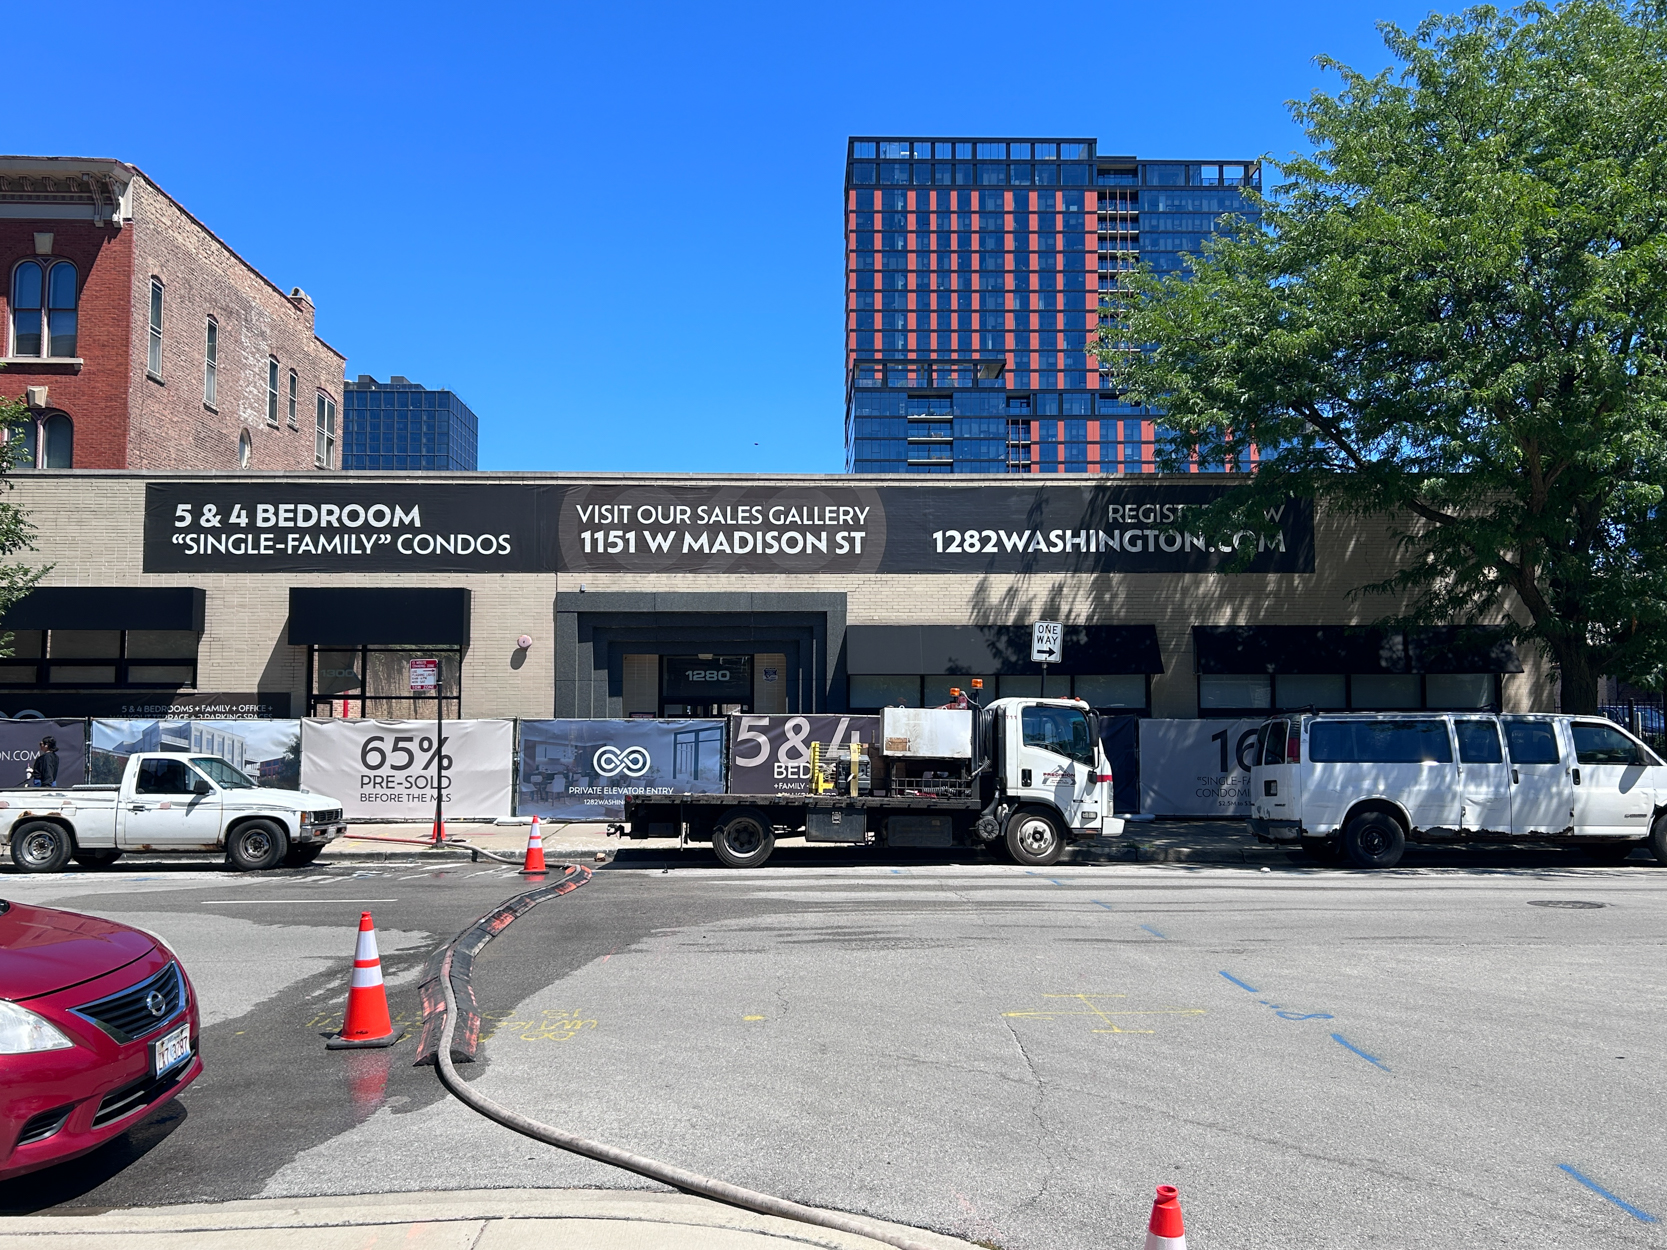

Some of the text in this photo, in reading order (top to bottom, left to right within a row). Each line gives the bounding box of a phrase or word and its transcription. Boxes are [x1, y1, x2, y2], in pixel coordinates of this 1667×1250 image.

[174, 503, 421, 528] 5 & 4 BEDROOM
[576, 505, 871, 525] VISIT OUR SALES GALLERY
[397, 533, 512, 555] CONDOS
[580, 530, 866, 554] 1151 W MADISON ST
[1037, 624, 1058, 635] ONE
[1036, 635, 1059, 645] WAY
[320, 669, 355, 678] 1300
[685, 670, 730, 681] 1280
[121, 705, 127, 713] 5
[136, 705, 142, 713] 4
[143, 705, 194, 713] BEDROOMS
[201, 704, 231, 712] FAMILY
[238, 704, 267, 712] OFFICE
[0, 750, 41, 761] N.COM
[360, 735, 453, 771] 65%
[360, 774, 452, 790] PRE-SOLD
[568, 786, 674, 795] PRIVATE ELEVATOR ENTRY
[1195, 788, 1250, 798] CONDOMI
[360, 793, 404, 803] BEFORE
[405, 793, 427, 802] THE
[583, 798, 625, 806] 1282WASHIN
